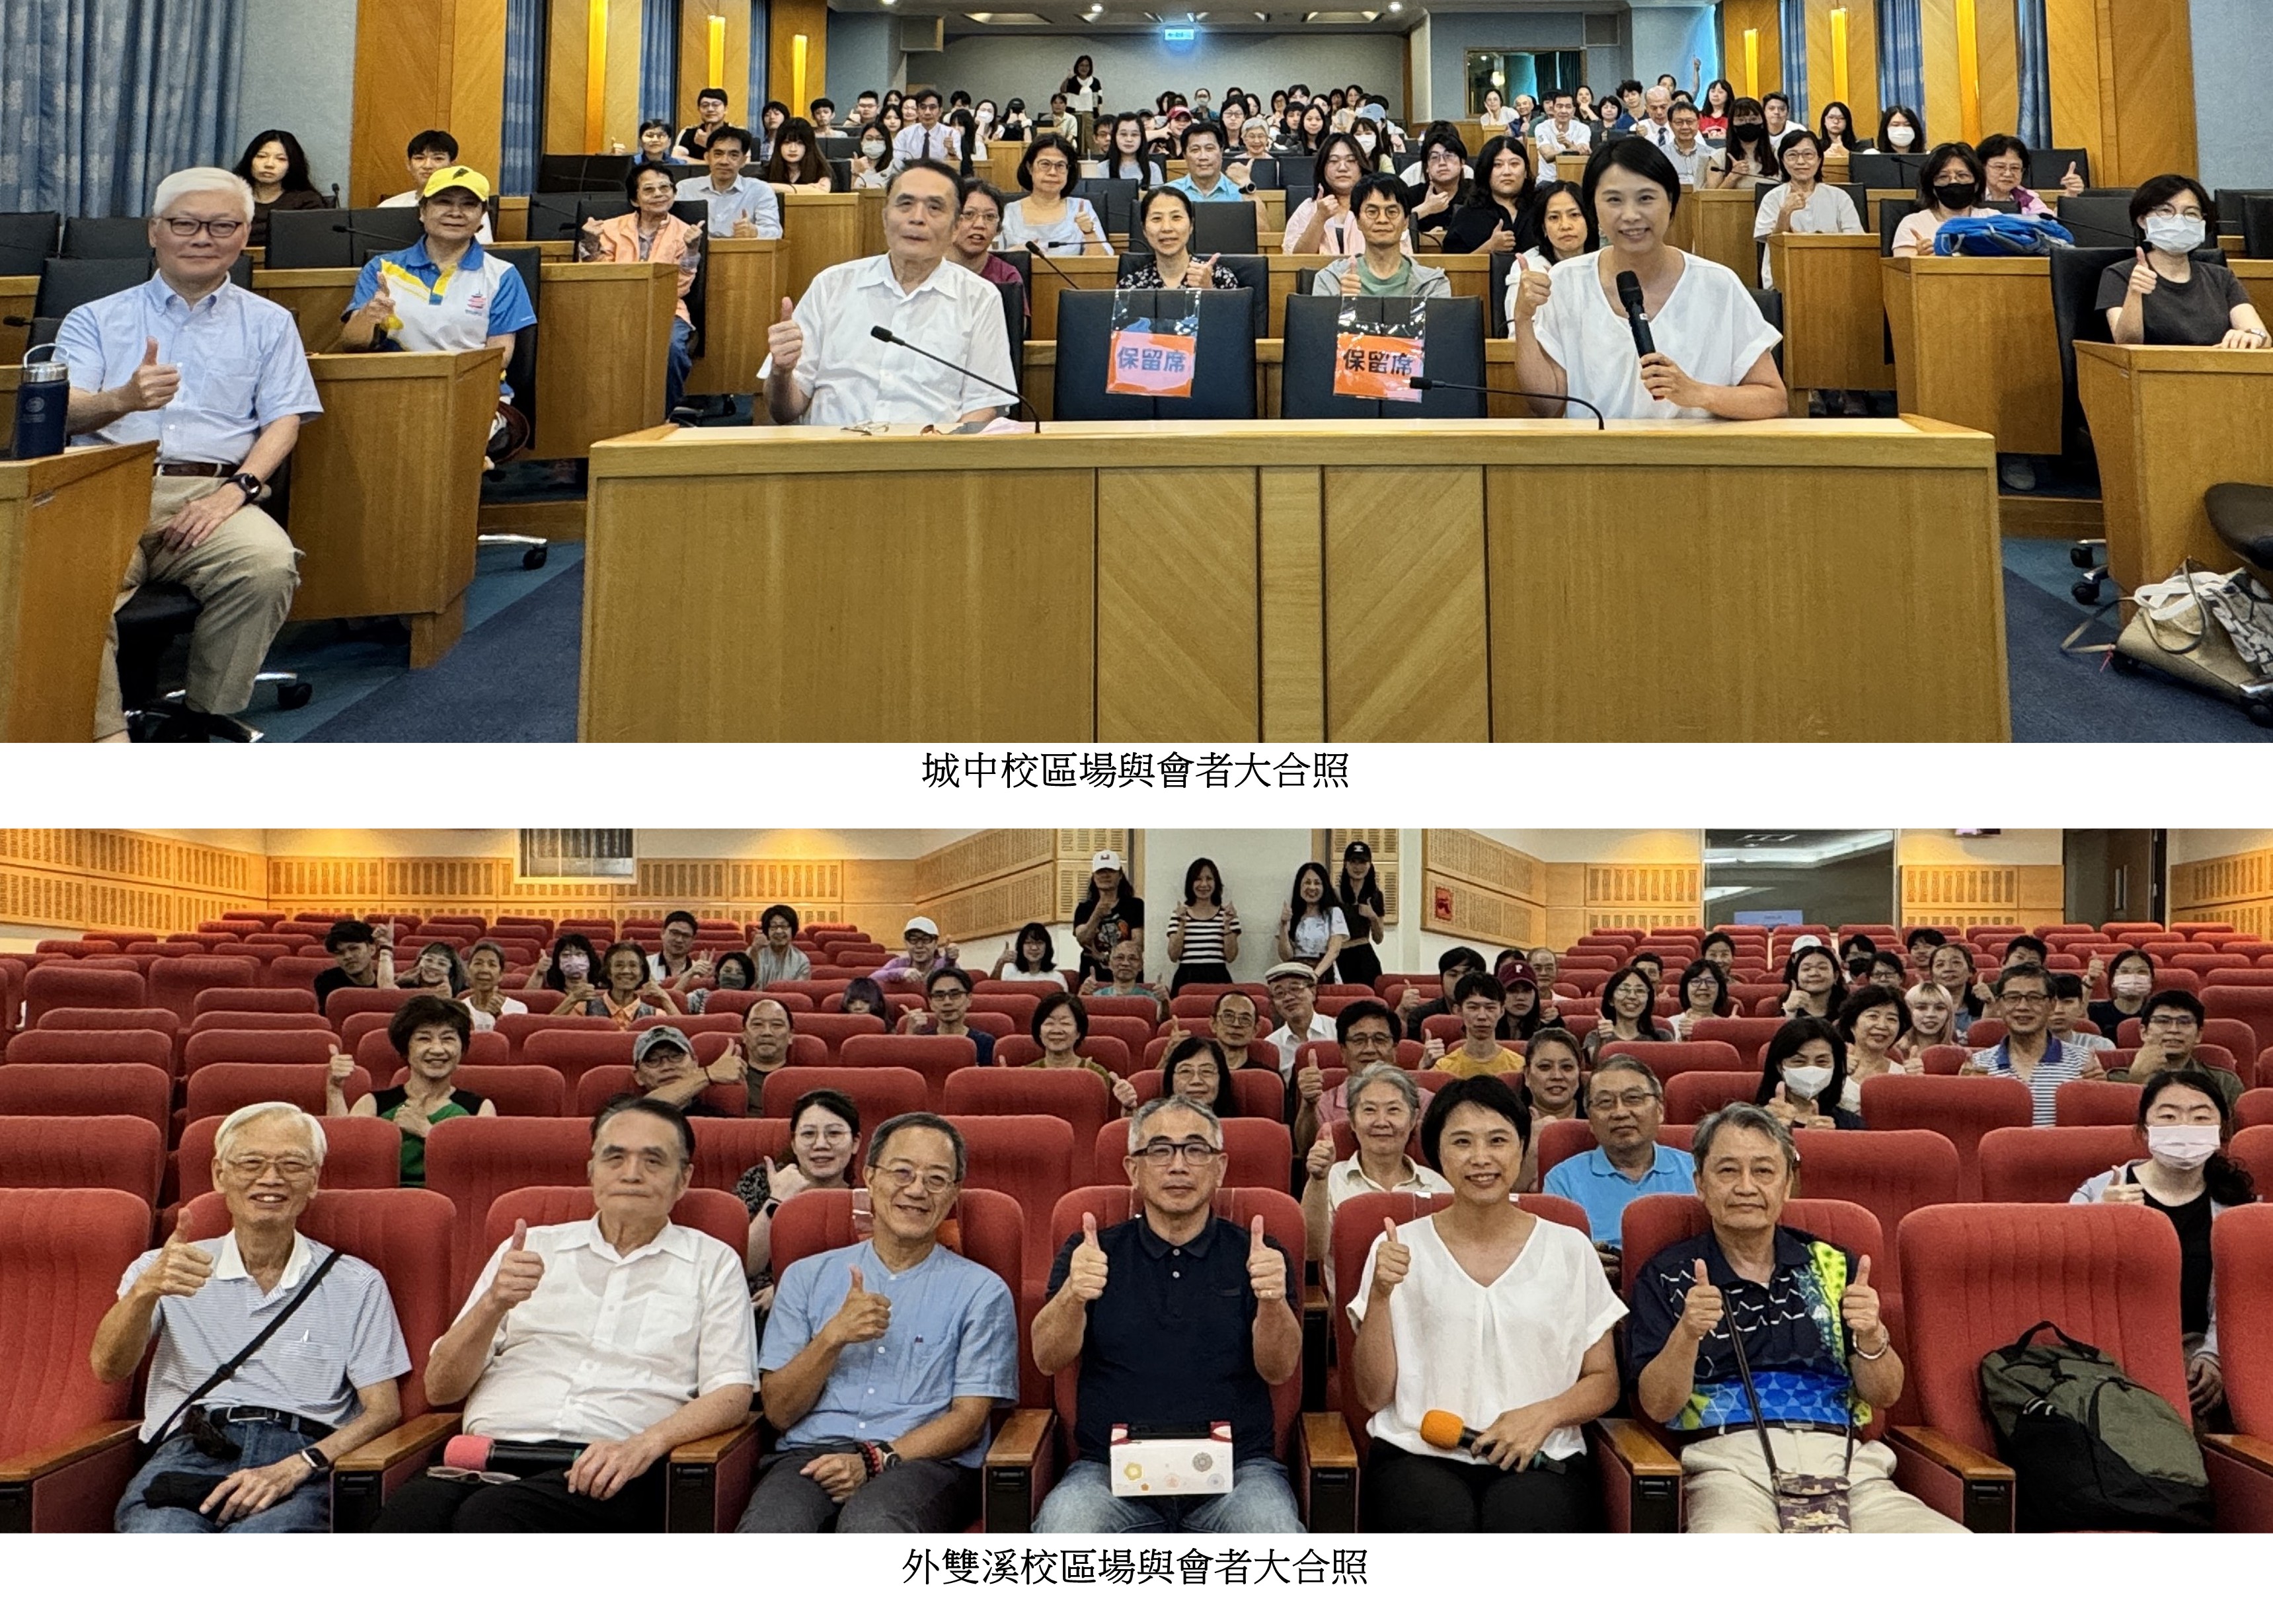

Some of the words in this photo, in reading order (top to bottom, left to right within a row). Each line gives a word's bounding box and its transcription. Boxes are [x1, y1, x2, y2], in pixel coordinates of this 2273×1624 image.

[1117, 346, 1186, 372] 保留席
[1343, 349, 1413, 375] 保留席
